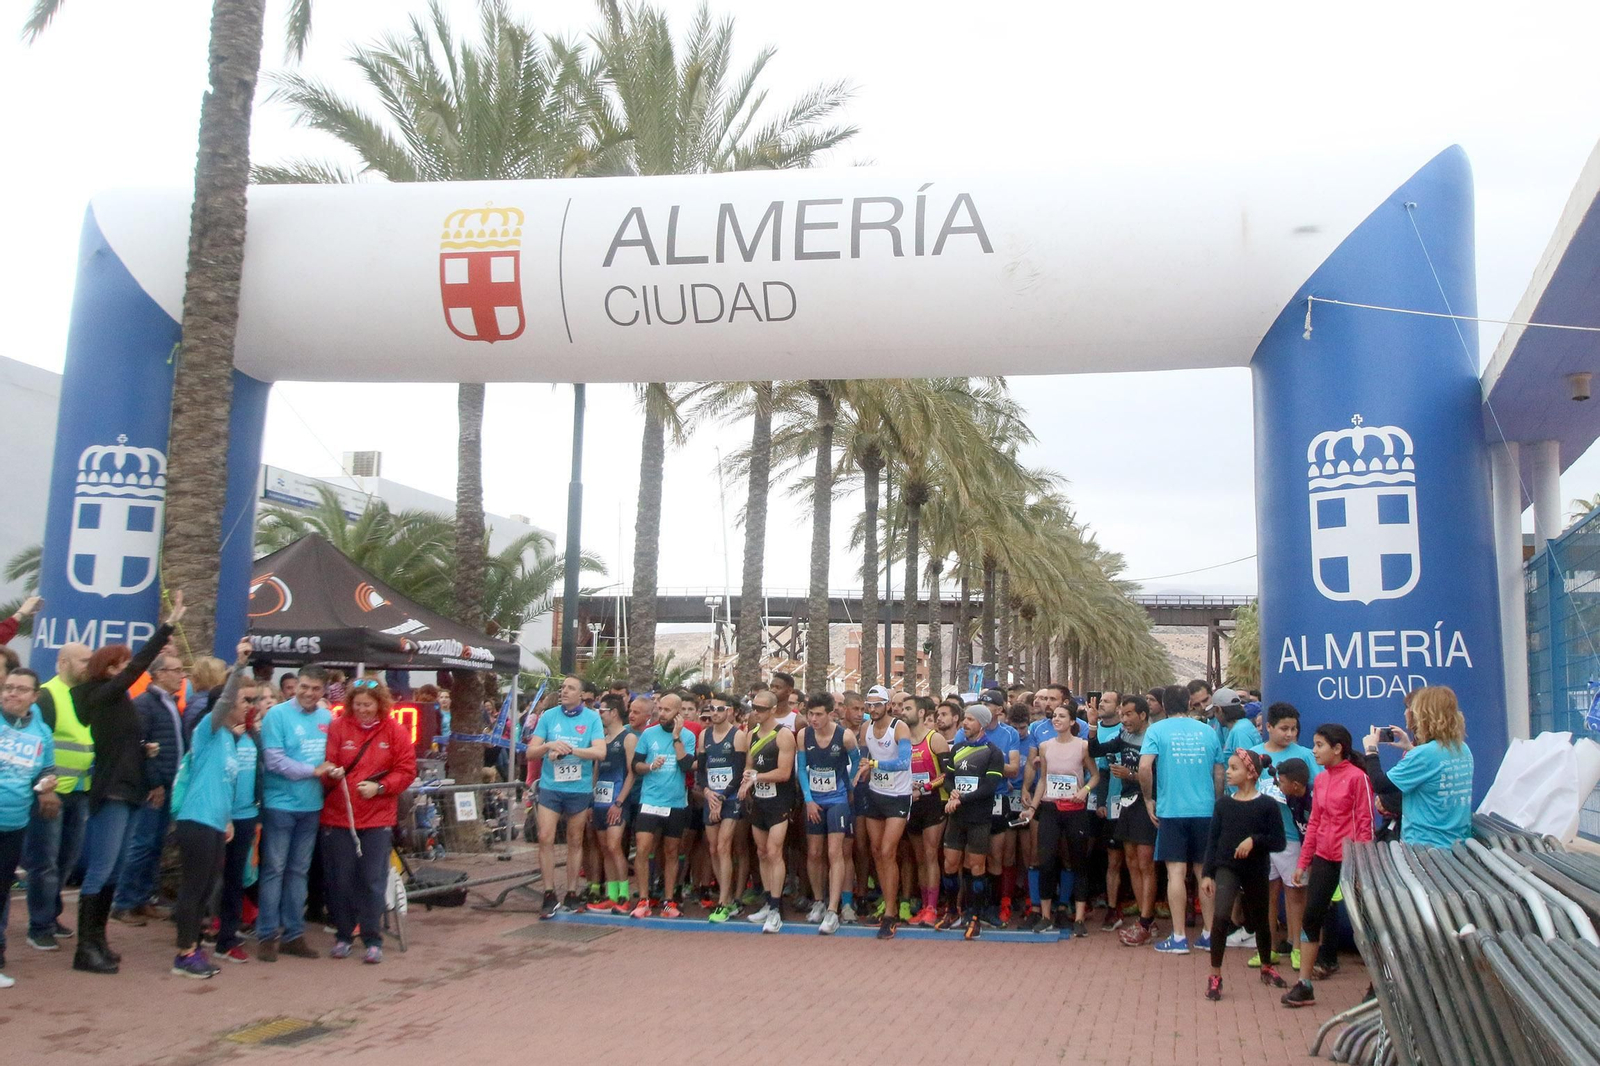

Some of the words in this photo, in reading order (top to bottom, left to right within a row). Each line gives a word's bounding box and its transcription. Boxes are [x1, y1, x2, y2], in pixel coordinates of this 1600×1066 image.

[602, 182, 994, 268] ALMERÍA
[604, 280, 798, 327] CIUDAD
[33, 616, 157, 651] ALMER
[1278, 620, 1473, 674] ALMERÍA
[559, 765, 578, 774] 313
[710, 773, 728, 783] 613
[812, 776, 831, 785] 614
[957, 783, 973, 792] 422
[1052, 781, 1072, 791] 725
